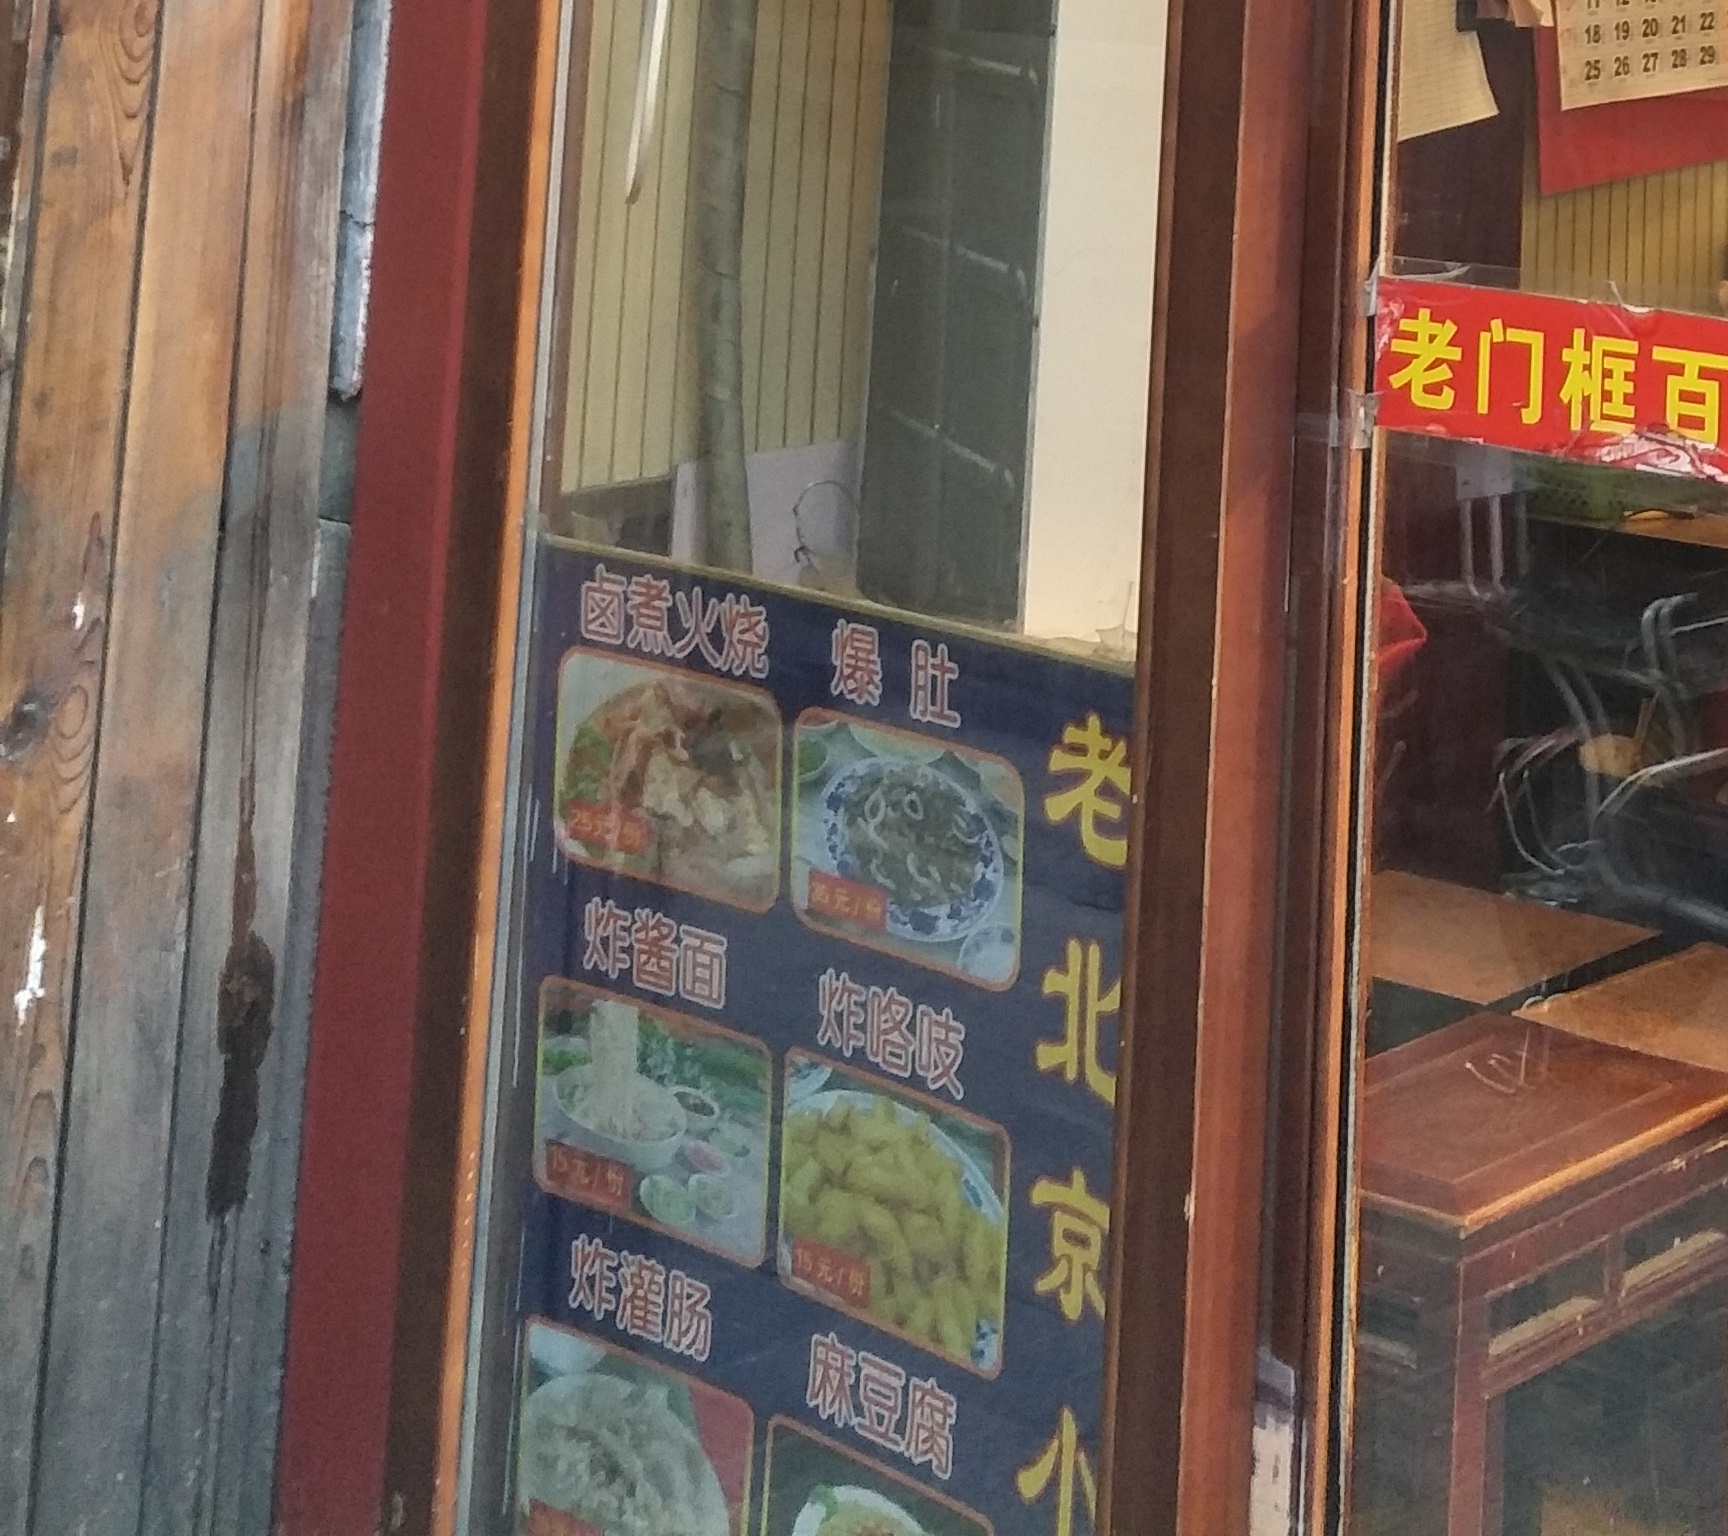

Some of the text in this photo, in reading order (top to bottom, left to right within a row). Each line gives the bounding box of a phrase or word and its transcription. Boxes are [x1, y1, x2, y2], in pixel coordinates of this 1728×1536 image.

[1584, 24, 1601, 45] 18
[1614, 20, 1630, 41] 19
[1642, 17, 1658, 38] 20
[1671, 15, 1686, 35] 21
[1700, 11, 1715, 31] 22
[1584, 60, 1601, 81] 25
[1613, 56, 1630, 77] 26
[1642, 52, 1659, 73] 27
[1700, 45, 1715, 65] 29
[580, 563, 769, 678] 卤煮火烧
[583, 896, 728, 1009] 炸酱面
[816, 968, 966, 1100] 炸咯吱
[568, 1232, 713, 1361] 炸灌肠
[806, 1331, 957, 1479] 麻豆腐
